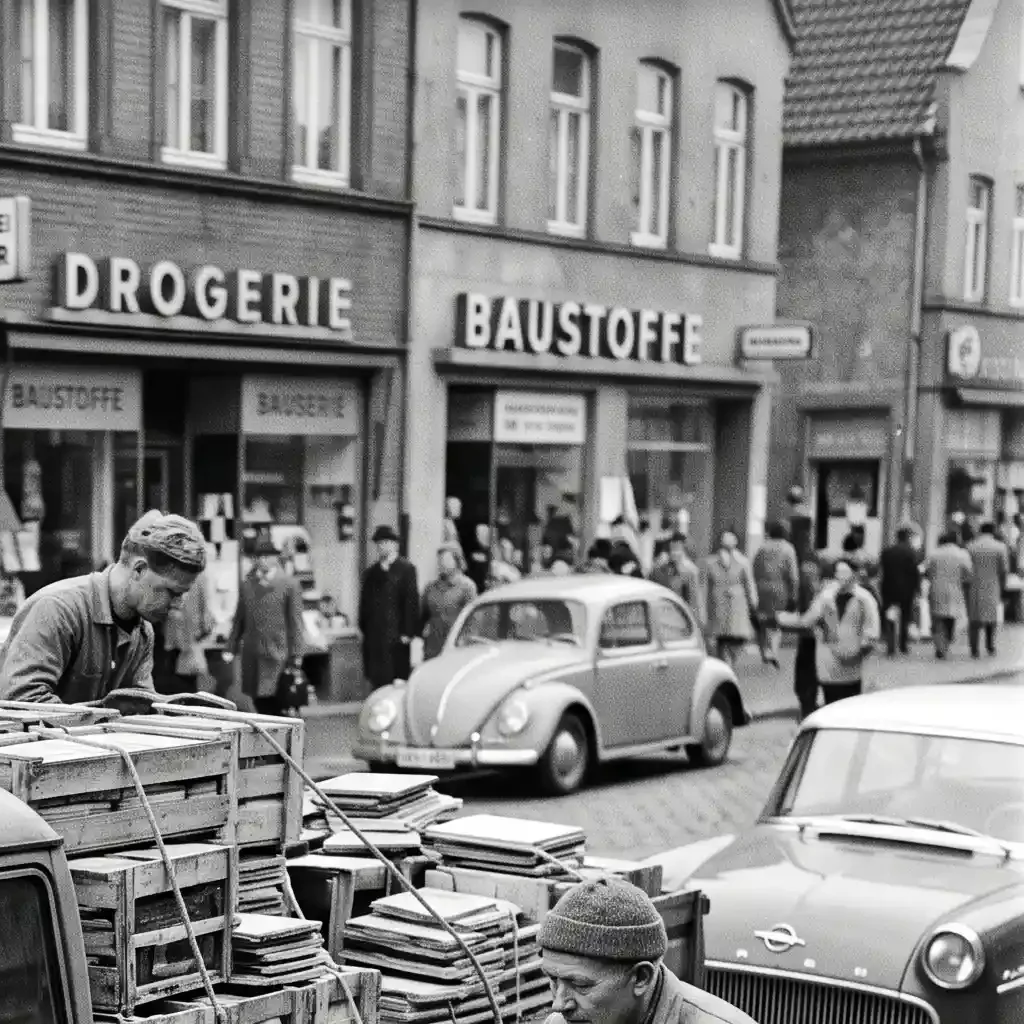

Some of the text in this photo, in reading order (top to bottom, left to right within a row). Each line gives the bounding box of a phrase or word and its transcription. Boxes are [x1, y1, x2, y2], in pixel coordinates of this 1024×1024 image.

[64, 252, 352, 329] DROGERIE
[464, 293, 703, 365] BAUSTOFFE
[12, 383, 124, 411] BAUSTOFFE
